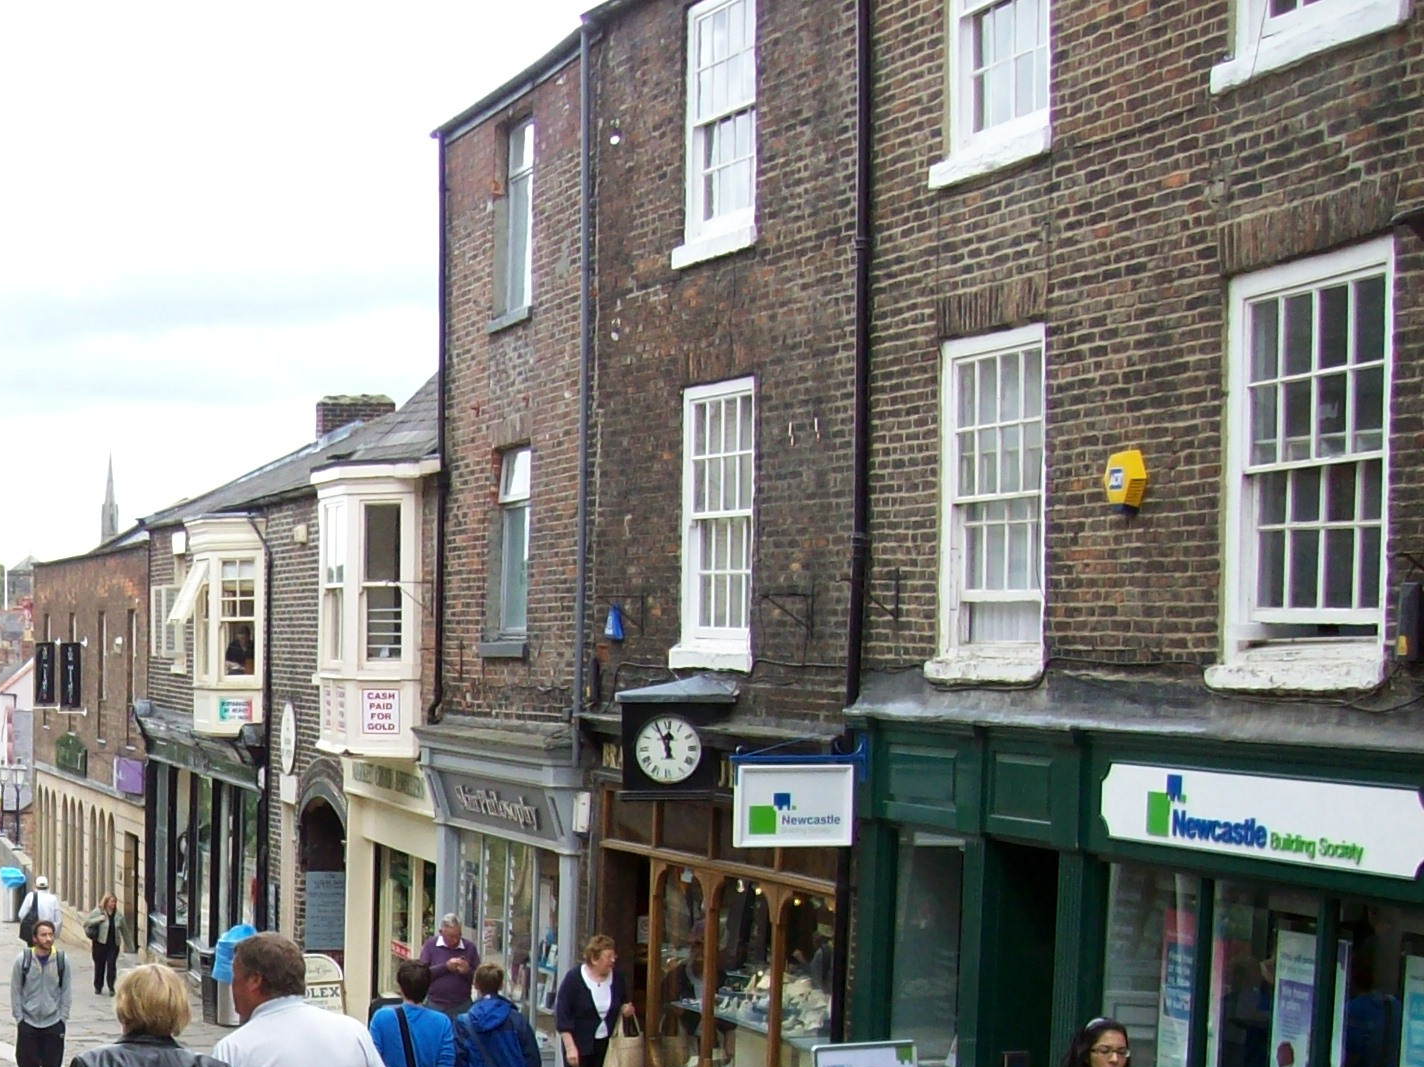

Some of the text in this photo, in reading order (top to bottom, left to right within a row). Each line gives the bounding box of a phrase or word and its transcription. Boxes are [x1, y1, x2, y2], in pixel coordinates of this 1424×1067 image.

[367, 692, 395, 700] CASH
[369, 702, 393, 710] PAID
[370, 712, 392, 720] FOR
[367, 723, 395, 731] GOLD
[782, 814, 842, 826] Newcastle
[1171, 808, 1364, 866] Newcastle Building Society
